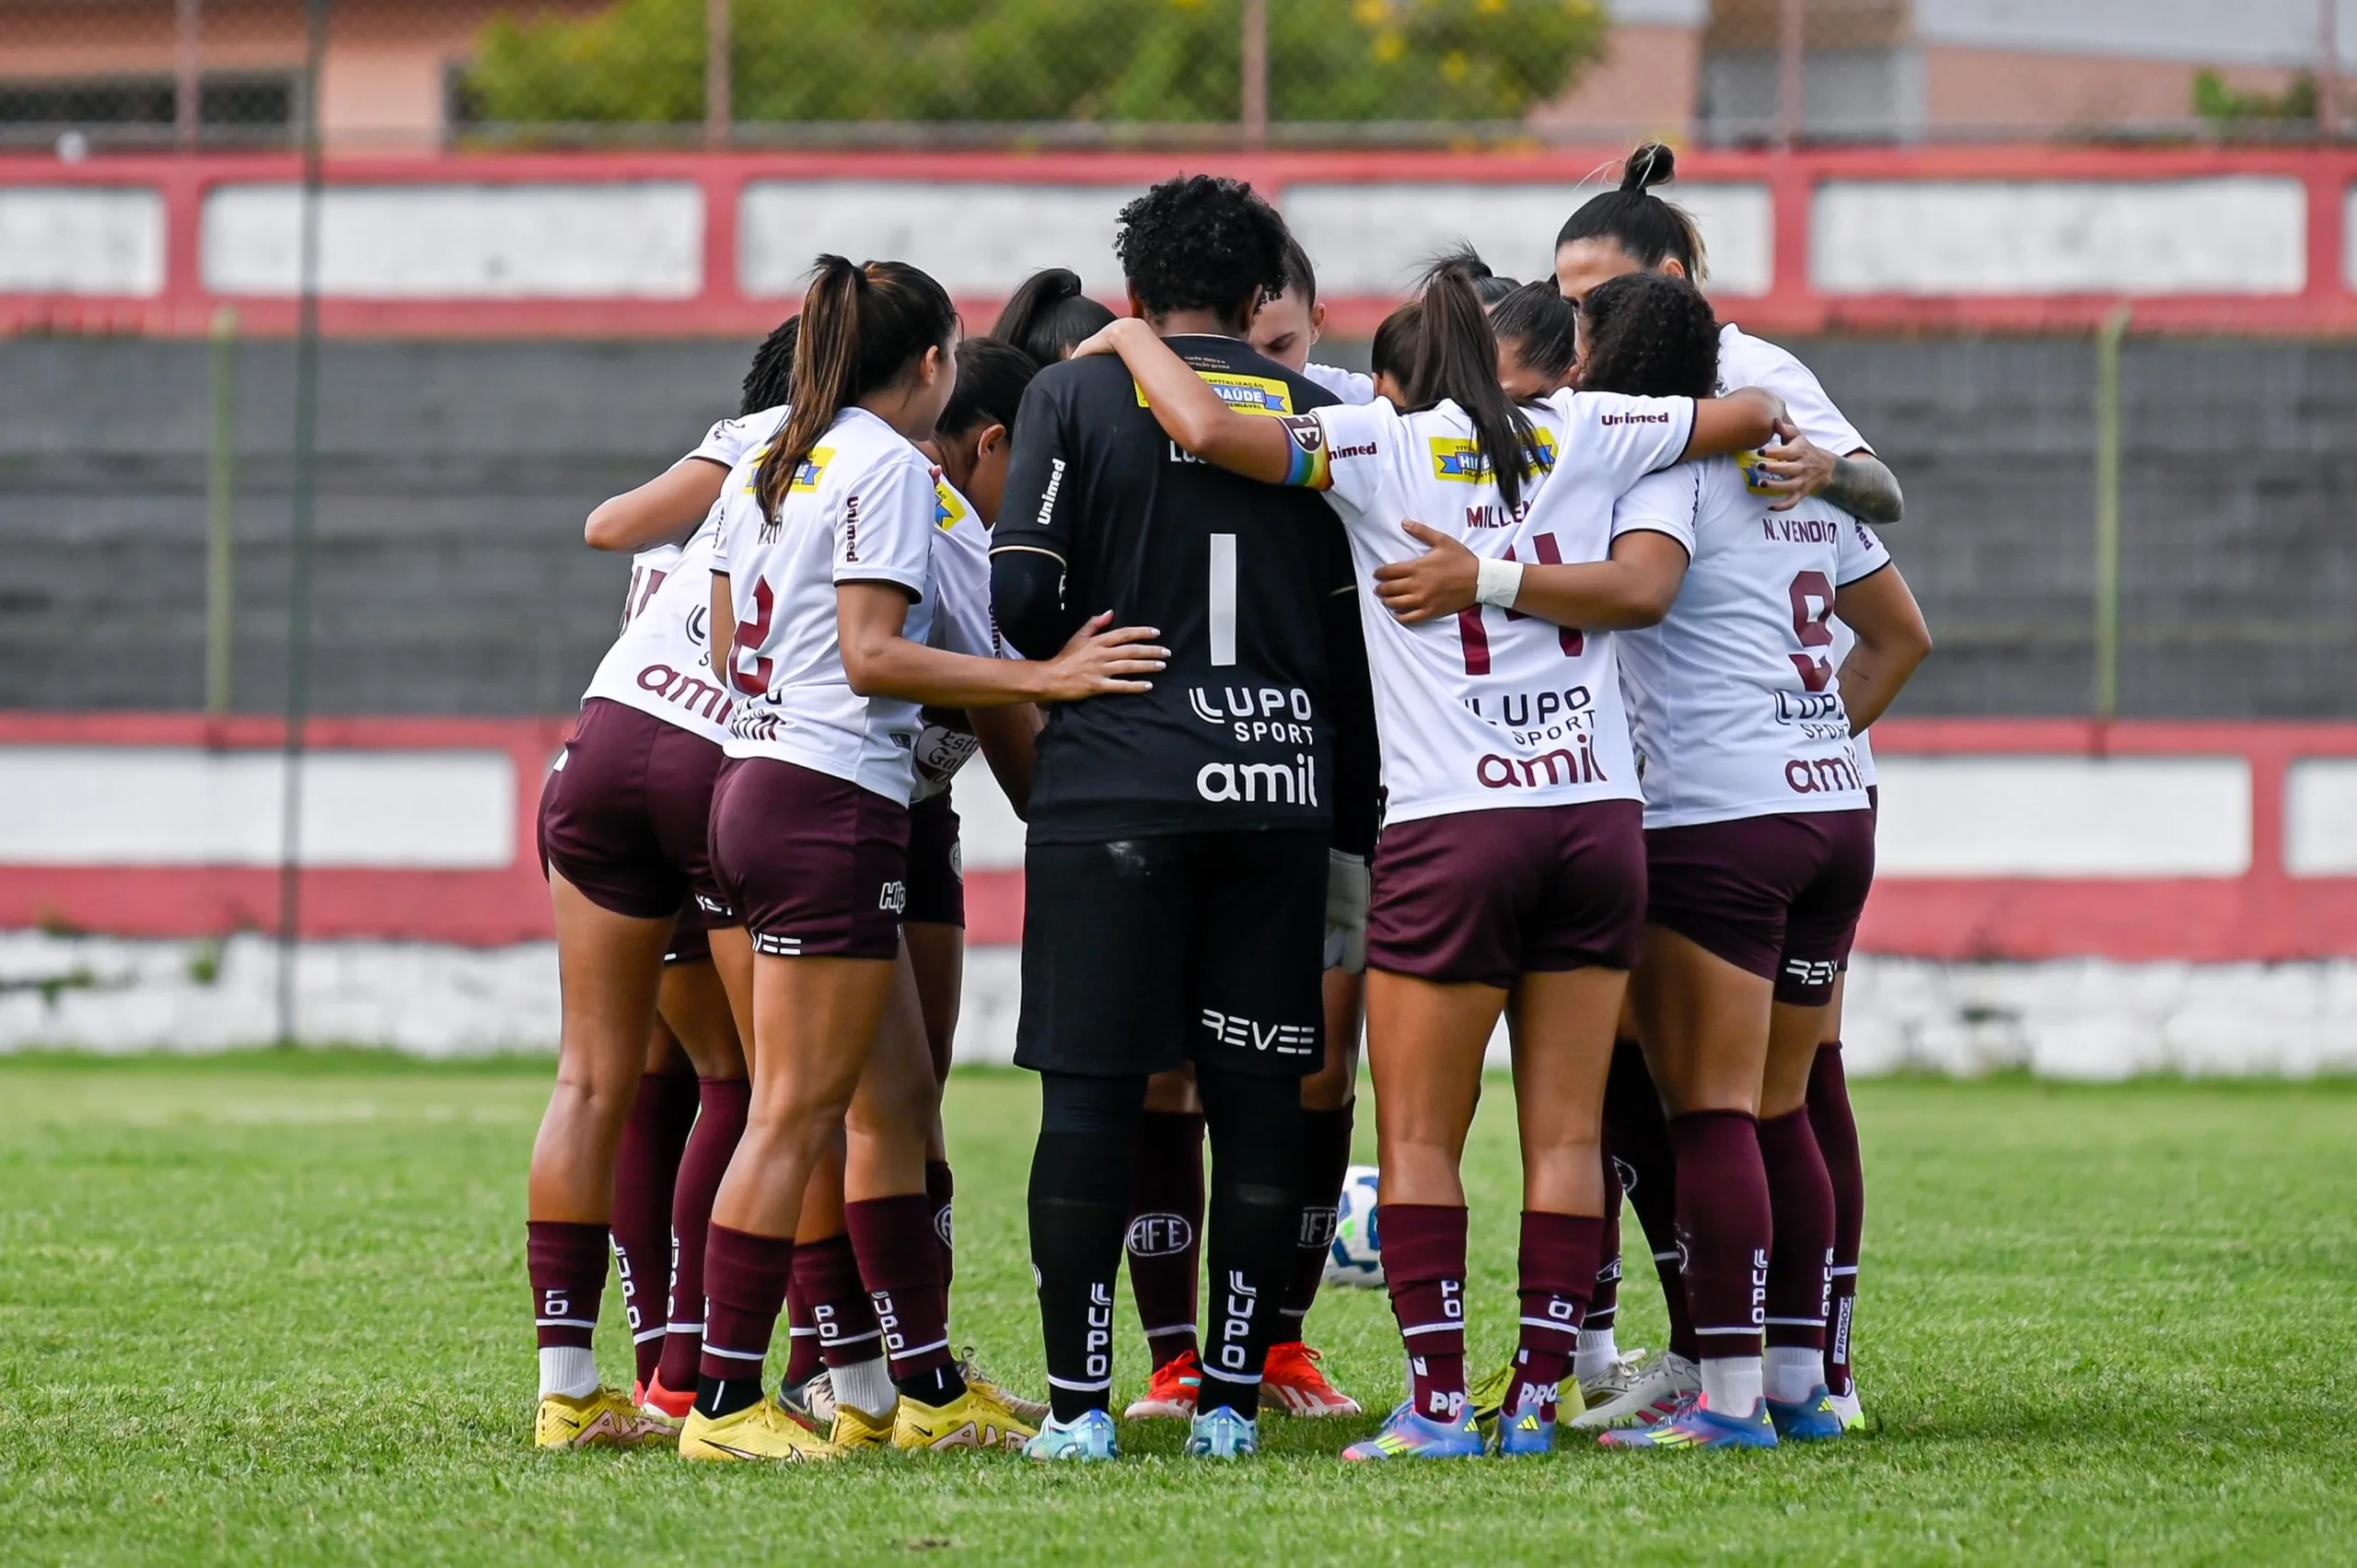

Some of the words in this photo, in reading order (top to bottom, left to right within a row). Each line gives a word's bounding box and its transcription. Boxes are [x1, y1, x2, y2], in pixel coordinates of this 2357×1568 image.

[1601, 412, 1669, 426] Unimed
[1329, 442, 1377, 461] nimed
[1037, 459, 1066, 526] Unimed
[846, 495, 859, 563] Unimed
[1210, 533, 1237, 666] 1
[729, 574, 773, 696] 2
[1787, 571, 1834, 692] 9
[637, 664, 734, 726] ami
[1189, 687, 1313, 724] LUPO
[1235, 721, 1314, 744] SPORT
[1512, 709, 1596, 746] SPORT
[1196, 753, 1318, 807] amil
[1477, 734, 1608, 789] amil
[1441, 1280, 1462, 1318] PO
[1752, 1249, 1769, 1324] LUPO
[814, 1304, 840, 1338] PO
[1086, 1283, 1112, 1377] LUPO
[1222, 1270, 1258, 1371] LUPO
